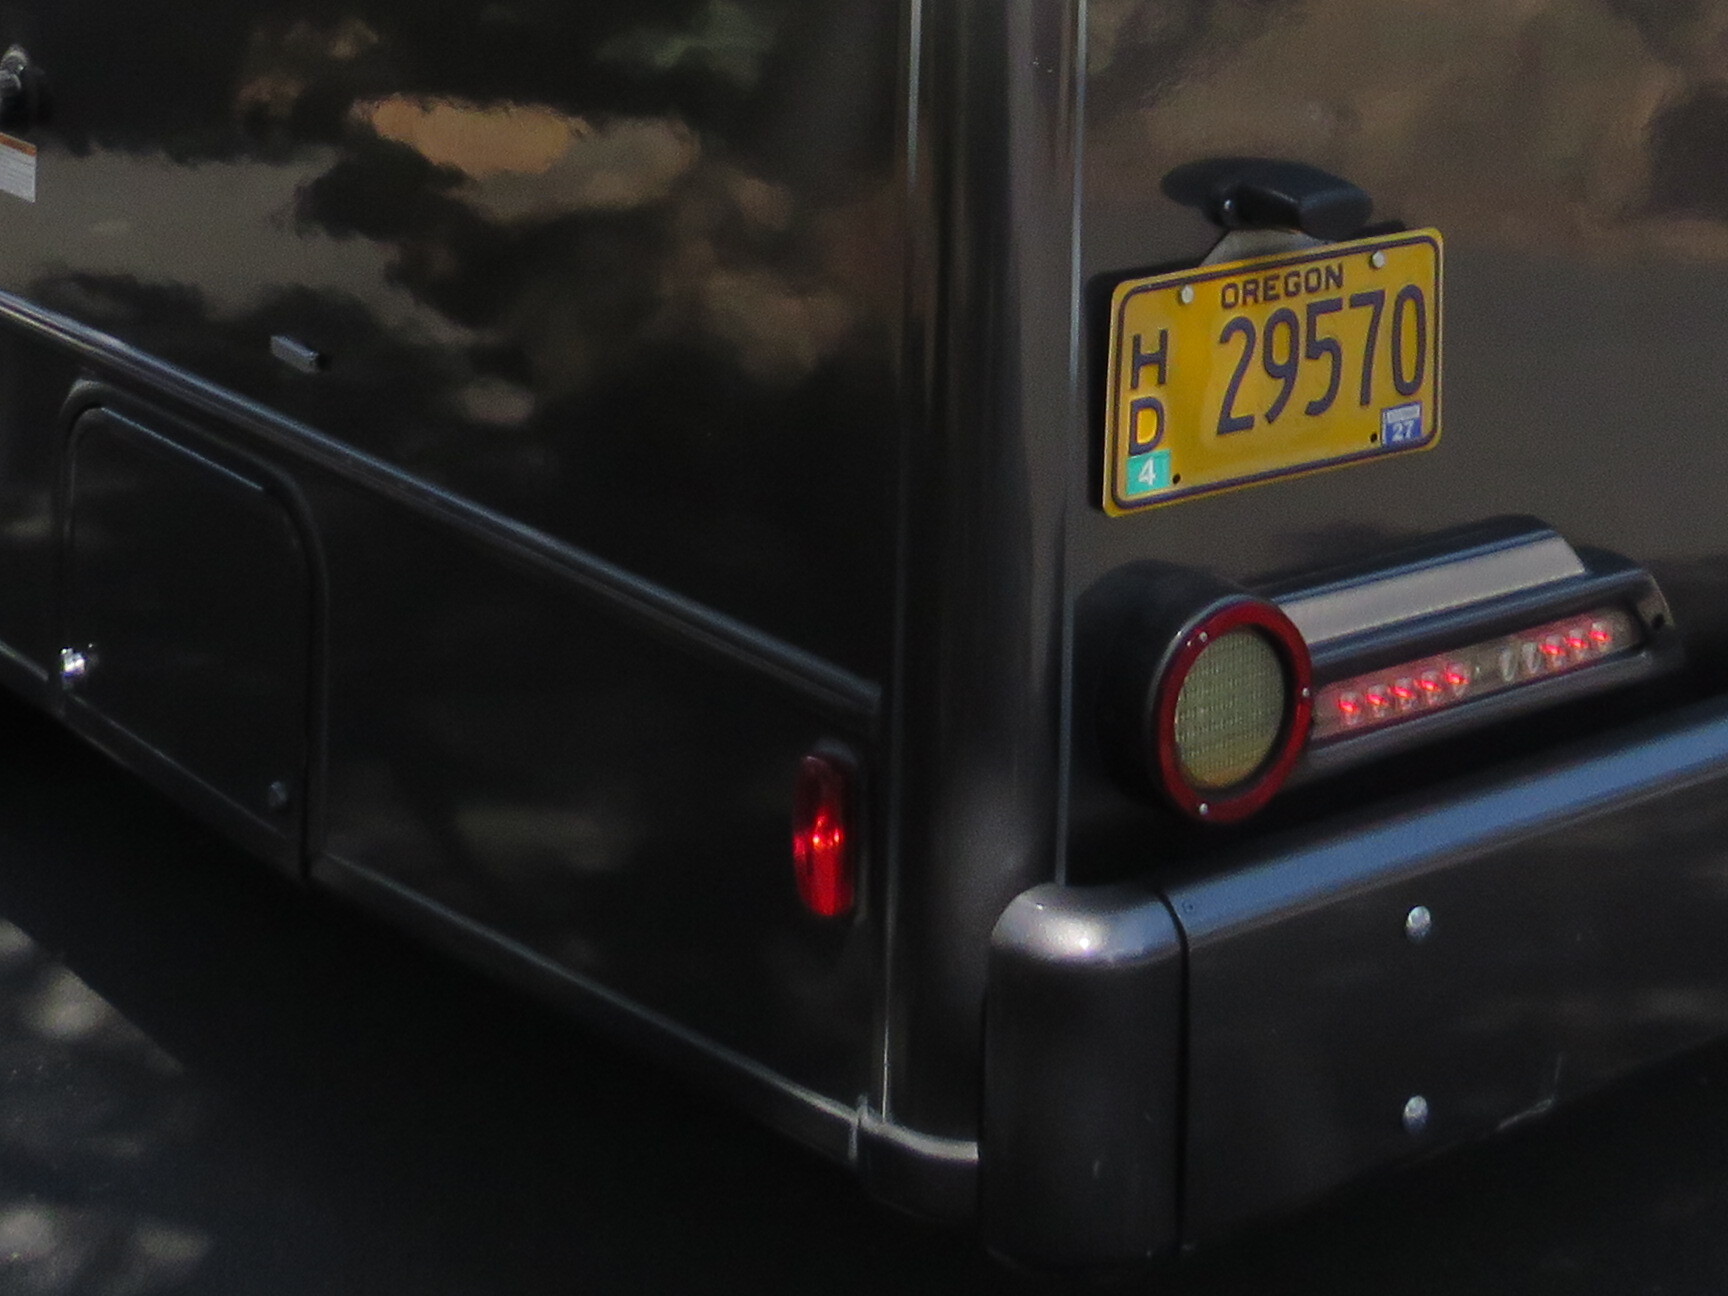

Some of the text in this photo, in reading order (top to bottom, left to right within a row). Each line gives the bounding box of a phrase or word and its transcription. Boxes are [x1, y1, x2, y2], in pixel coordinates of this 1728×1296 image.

[1220, 264, 1345, 311] OREGON
[1216, 283, 1427, 437] 29570
[1391, 419, 1415, 442] 27
[1137, 458, 1158, 487] 4
